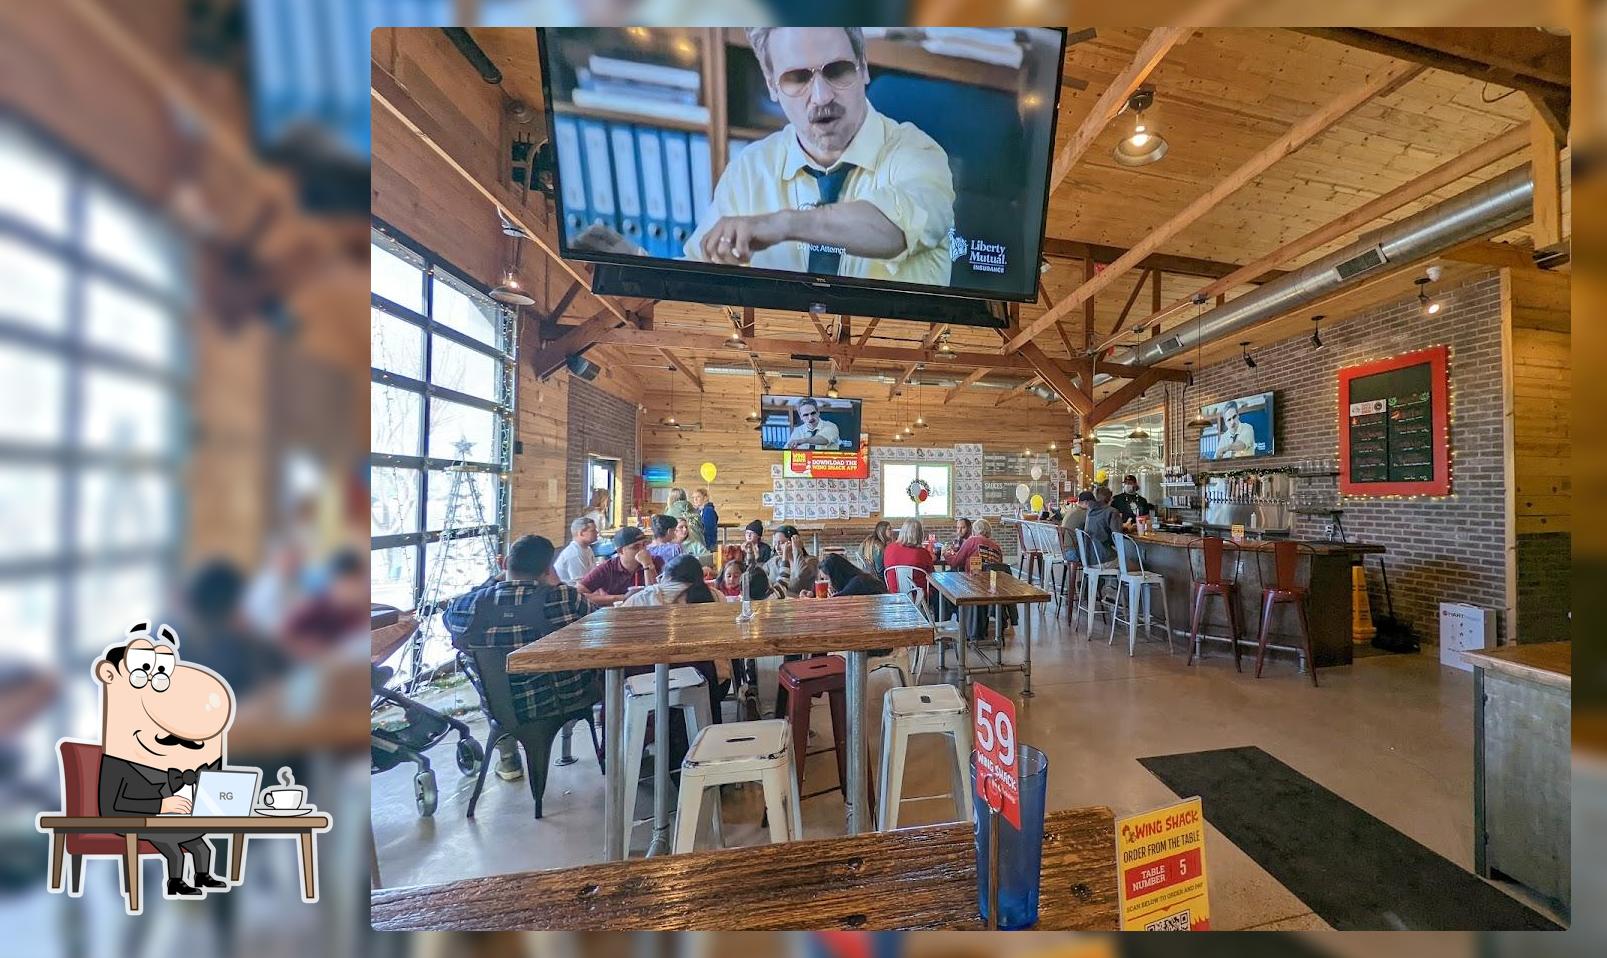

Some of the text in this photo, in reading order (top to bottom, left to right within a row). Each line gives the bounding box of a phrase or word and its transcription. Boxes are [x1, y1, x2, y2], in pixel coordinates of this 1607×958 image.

[808, 243, 820, 252] Not
[820, 245, 846, 256] Attempt
[971, 240, 1006, 256] Liberty
[972, 264, 1005, 274] INSURANCE
[977, 698, 1015, 766] 59
[977, 751, 1017, 791] WING SHACK
[1135, 811, 1199, 839] WING SHACK
[1123, 830, 1200, 863] ORDER FROM THE TABLE
[1141, 864, 1166, 879] TABLE
[1179, 858, 1187, 876] 5
[1132, 874, 1166, 892] NUMBER
[1126, 902, 1141, 913] SCAN
[1141, 897, 1159, 908] BELOW
[1167, 889, 1183, 900] ORDER
[1184, 885, 1195, 894] AND
